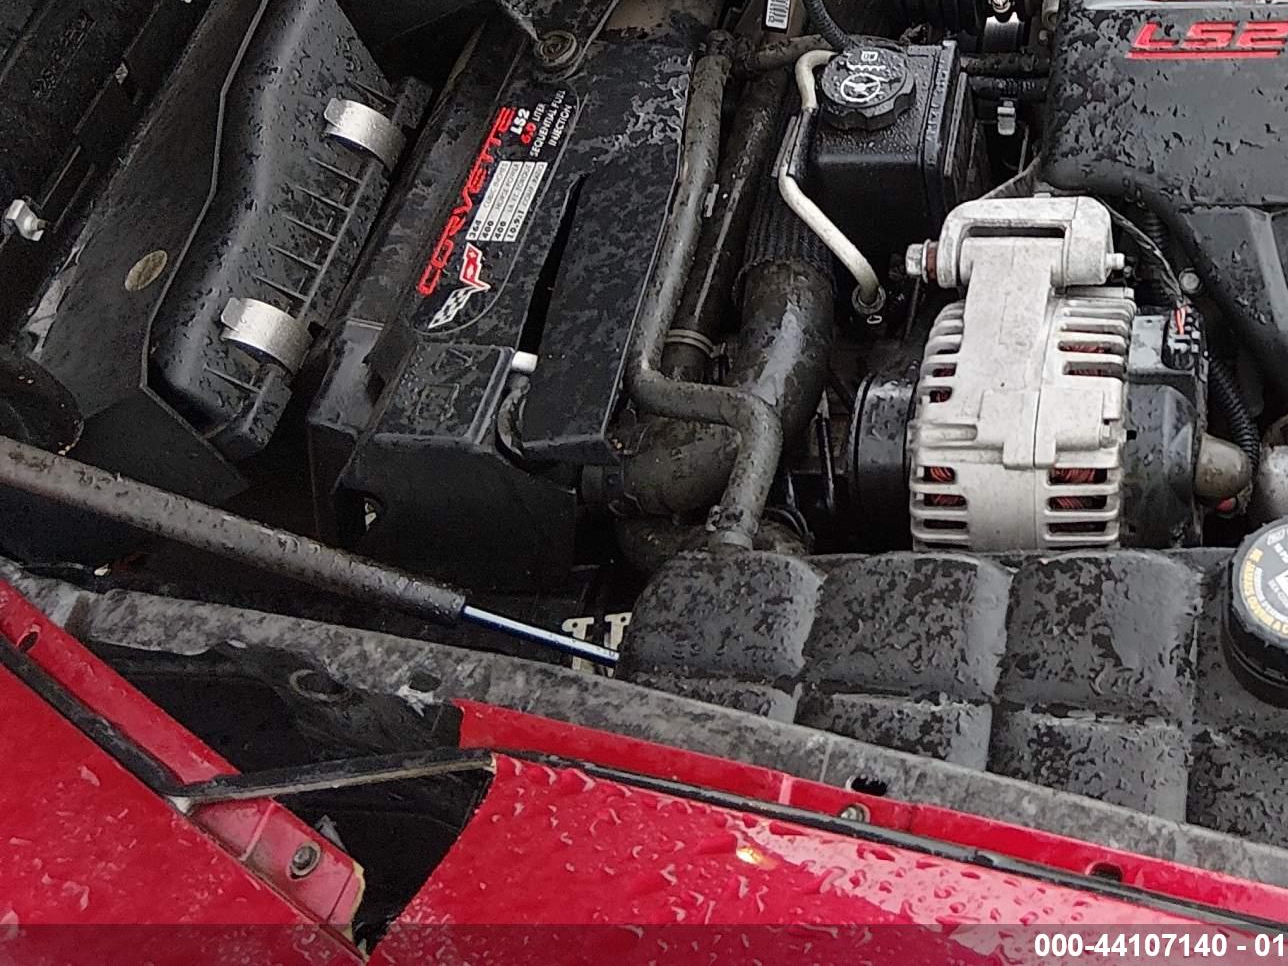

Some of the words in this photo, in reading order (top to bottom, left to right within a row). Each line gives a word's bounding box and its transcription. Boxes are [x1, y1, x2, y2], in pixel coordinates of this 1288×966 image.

[510, 108, 530, 135] LS2
[520, 122, 537, 144] 6.0
[532, 102, 546, 122] LITER
[529, 108, 556, 157] SEQUENTIAL
[551, 89, 566, 110] FUEL
[548, 105, 572, 146] INJECTION
[417, 106, 516, 295] CORVETTE
[481, 220, 494, 238] 400
[494, 220, 506, 239] 400
